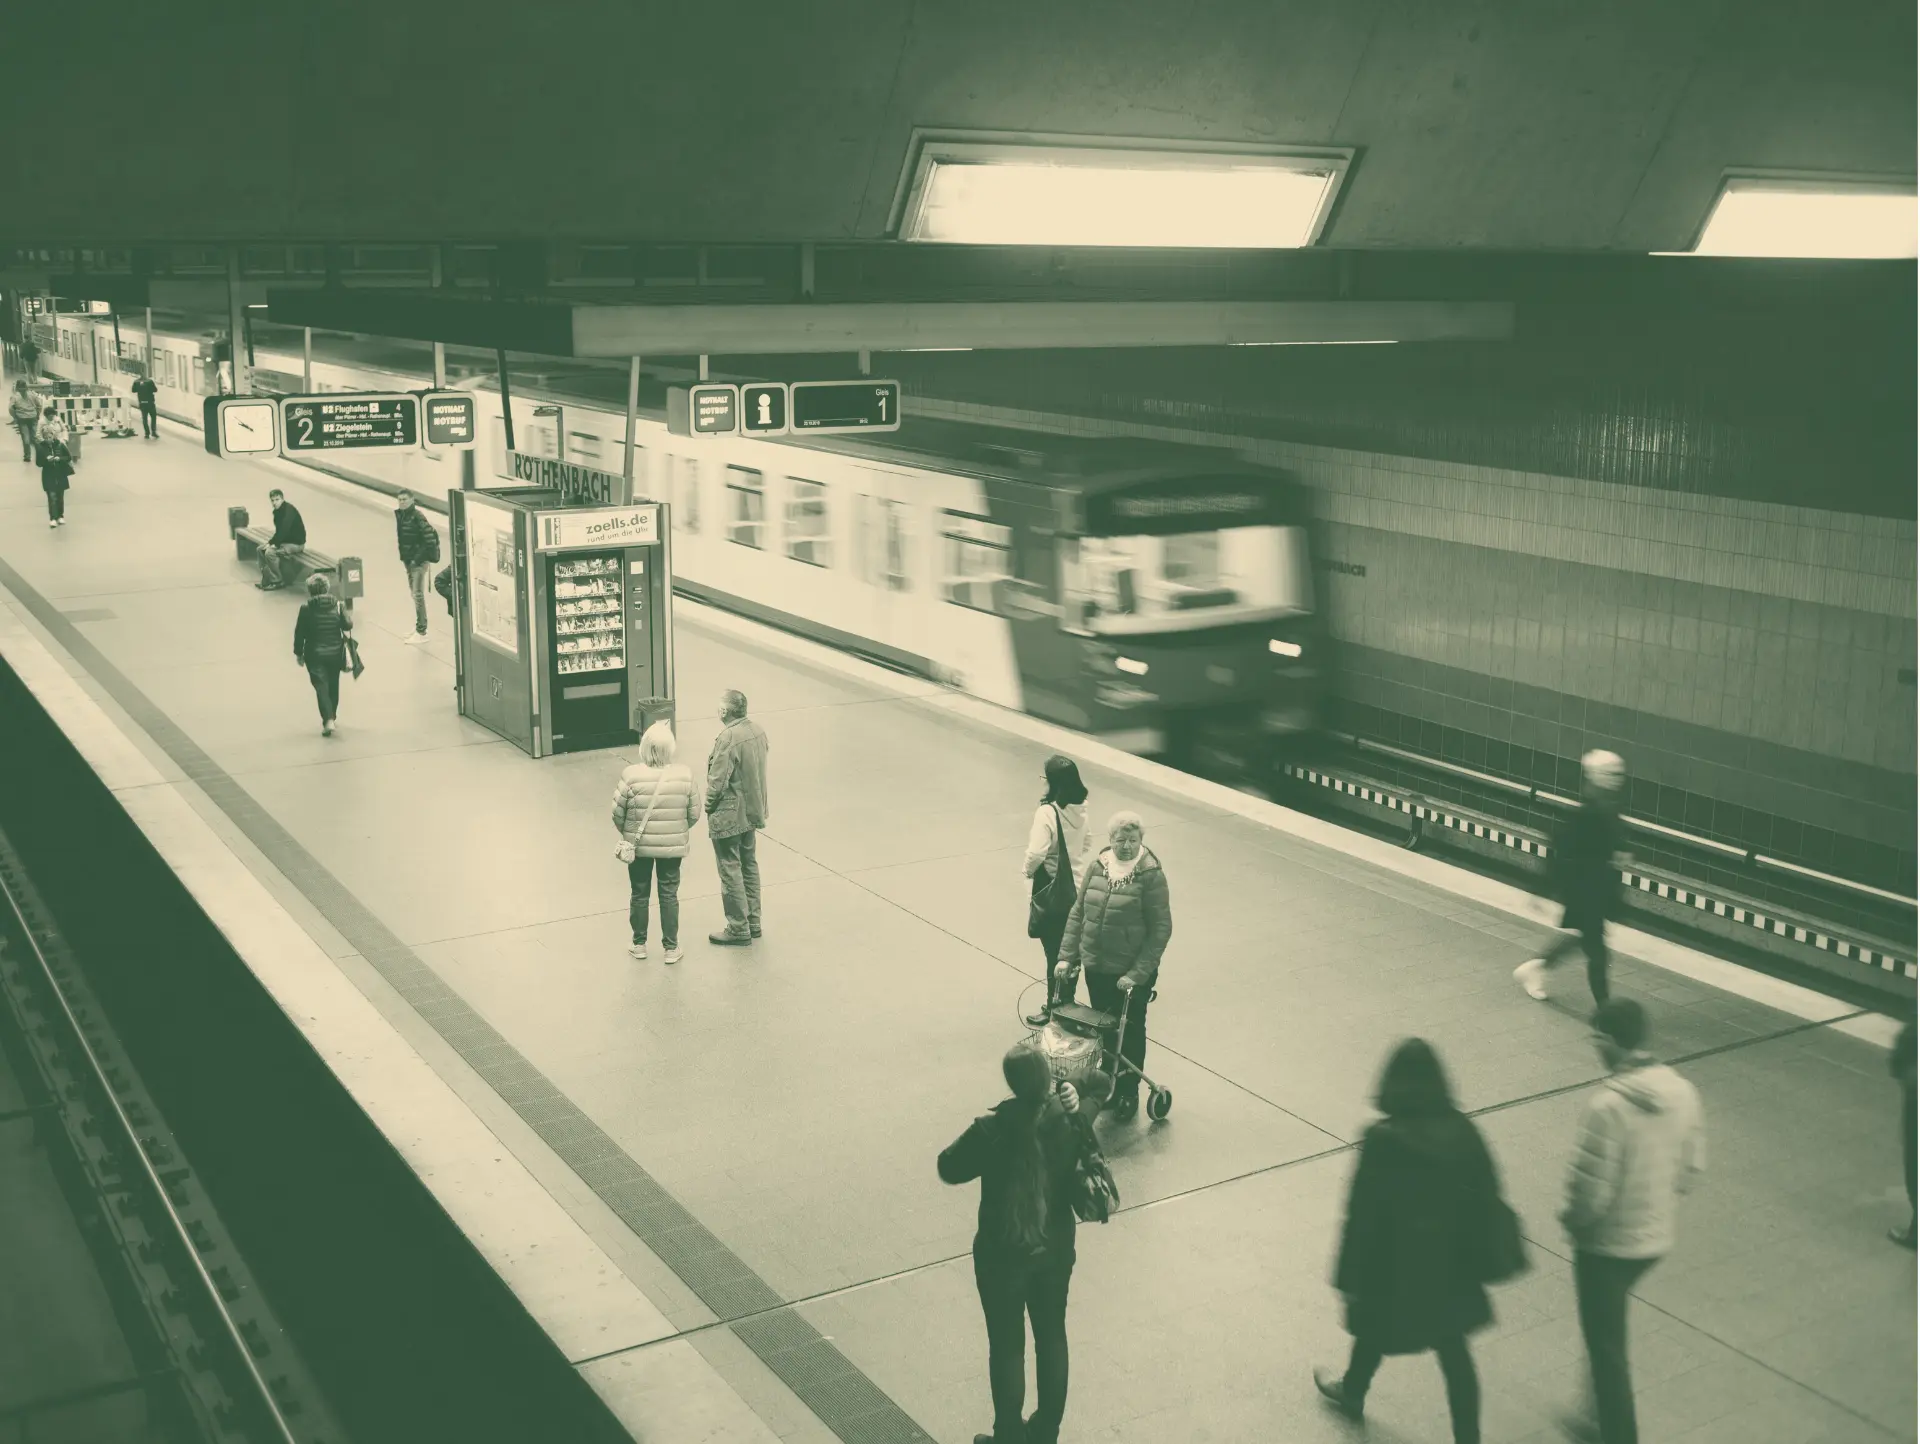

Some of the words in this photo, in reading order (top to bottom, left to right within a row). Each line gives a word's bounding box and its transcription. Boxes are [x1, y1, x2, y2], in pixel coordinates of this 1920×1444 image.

[875, 388, 889, 396] Gleis
[295, 407, 313, 416] Gleis
[322, 405, 334, 414] U2
[334, 404, 369, 414] Flughafen
[395, 403, 401, 411] 4
[433, 405, 465, 414] NOTHALT
[699, 406, 728, 415] NOTRUF
[878, 396, 886, 422] 1
[433, 416, 466, 425] NOTRUF
[297, 417, 314, 446] 2
[323, 424, 335, 433] U2
[335, 423, 372, 433] Ziegelstein
[514, 453, 611, 503] RÖTHENBACH
[585, 513, 648, 535] zoells.de
[587, 534, 605, 544] rund
[607, 530, 619, 540] um
[621, 528, 633, 537] die
[635, 526, 649, 535] Uhr
